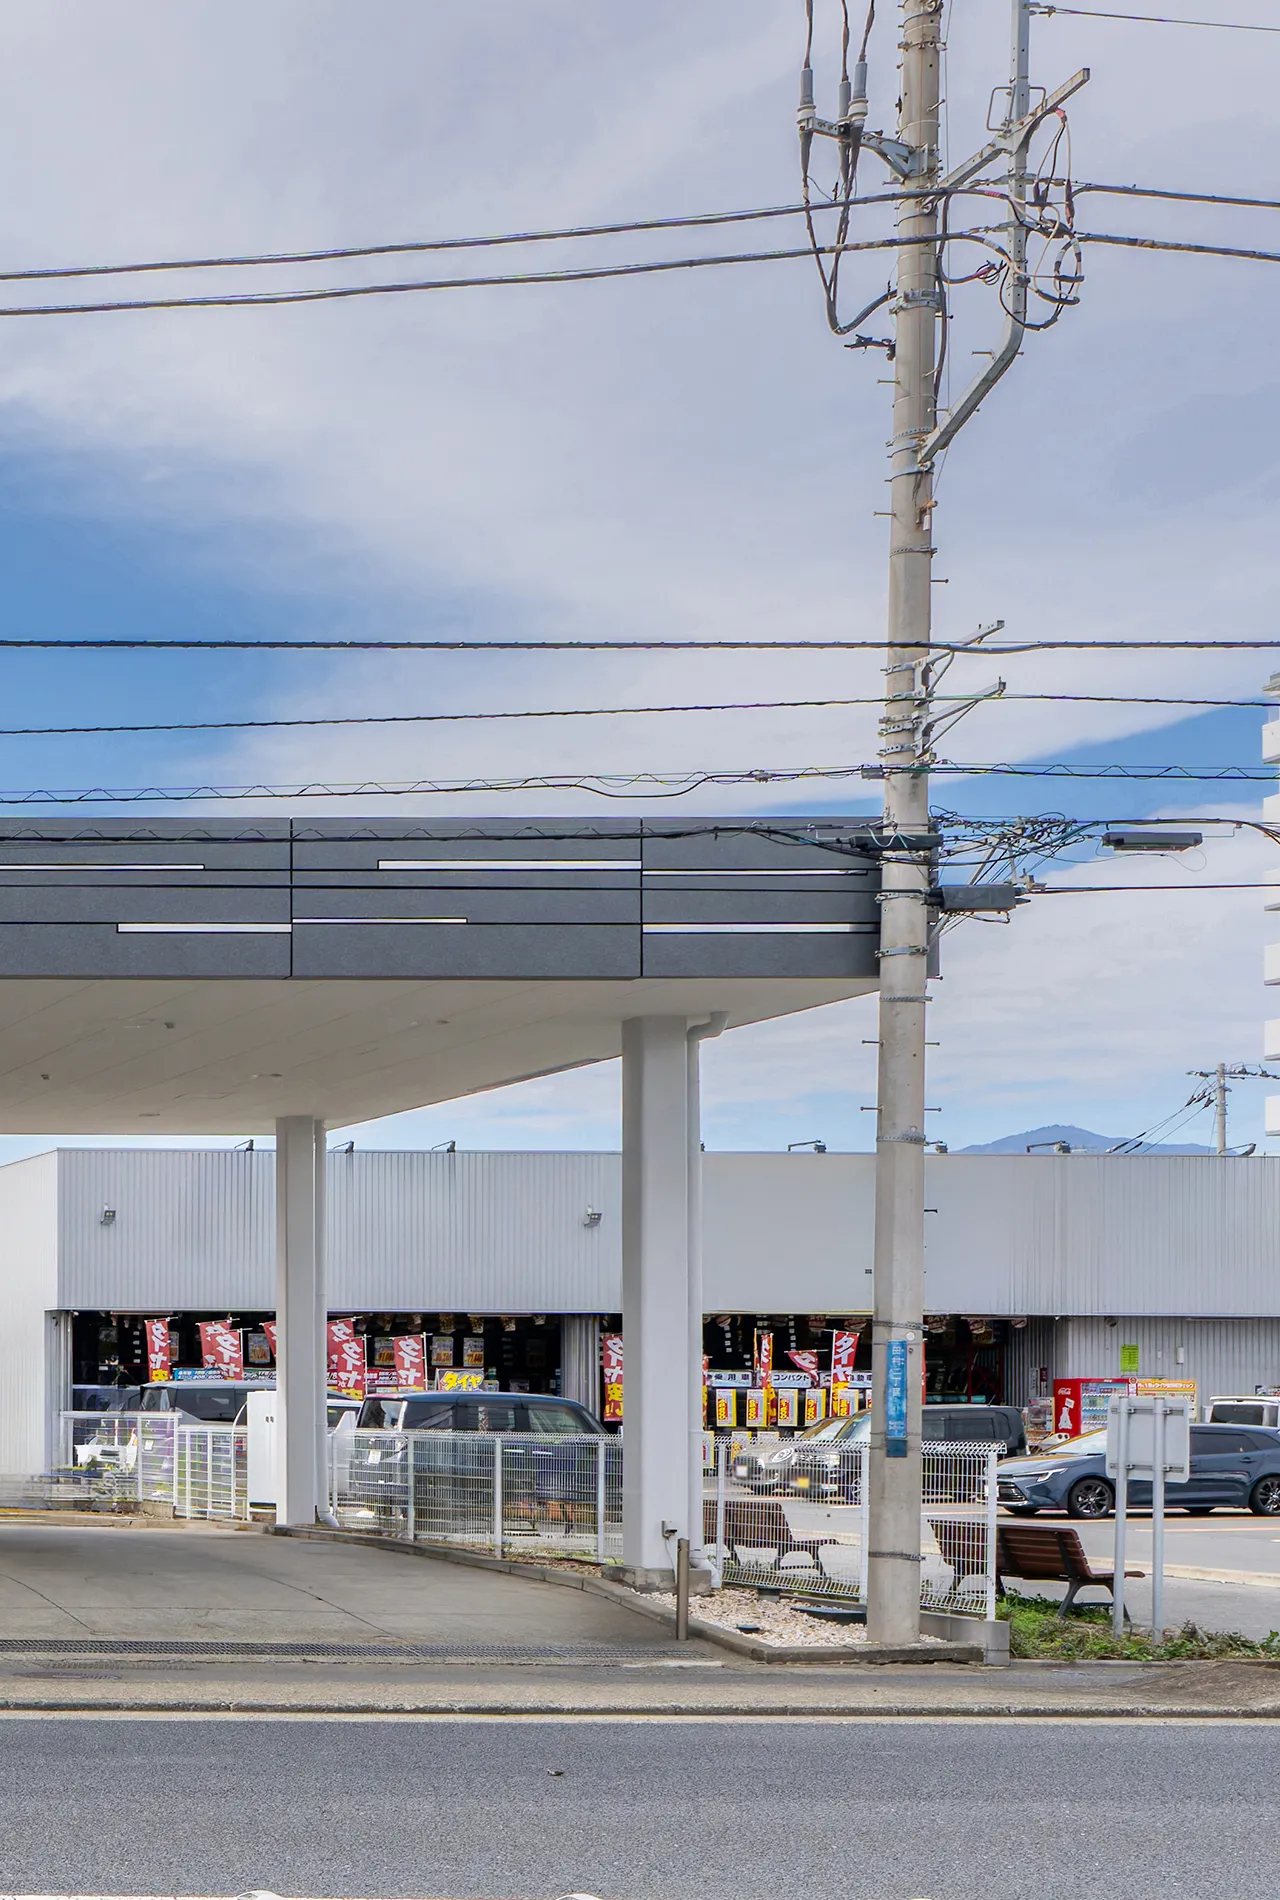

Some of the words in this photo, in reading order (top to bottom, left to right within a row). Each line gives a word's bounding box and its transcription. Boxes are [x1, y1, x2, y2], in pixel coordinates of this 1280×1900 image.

[772, 1373, 810, 1382] コンパクト
